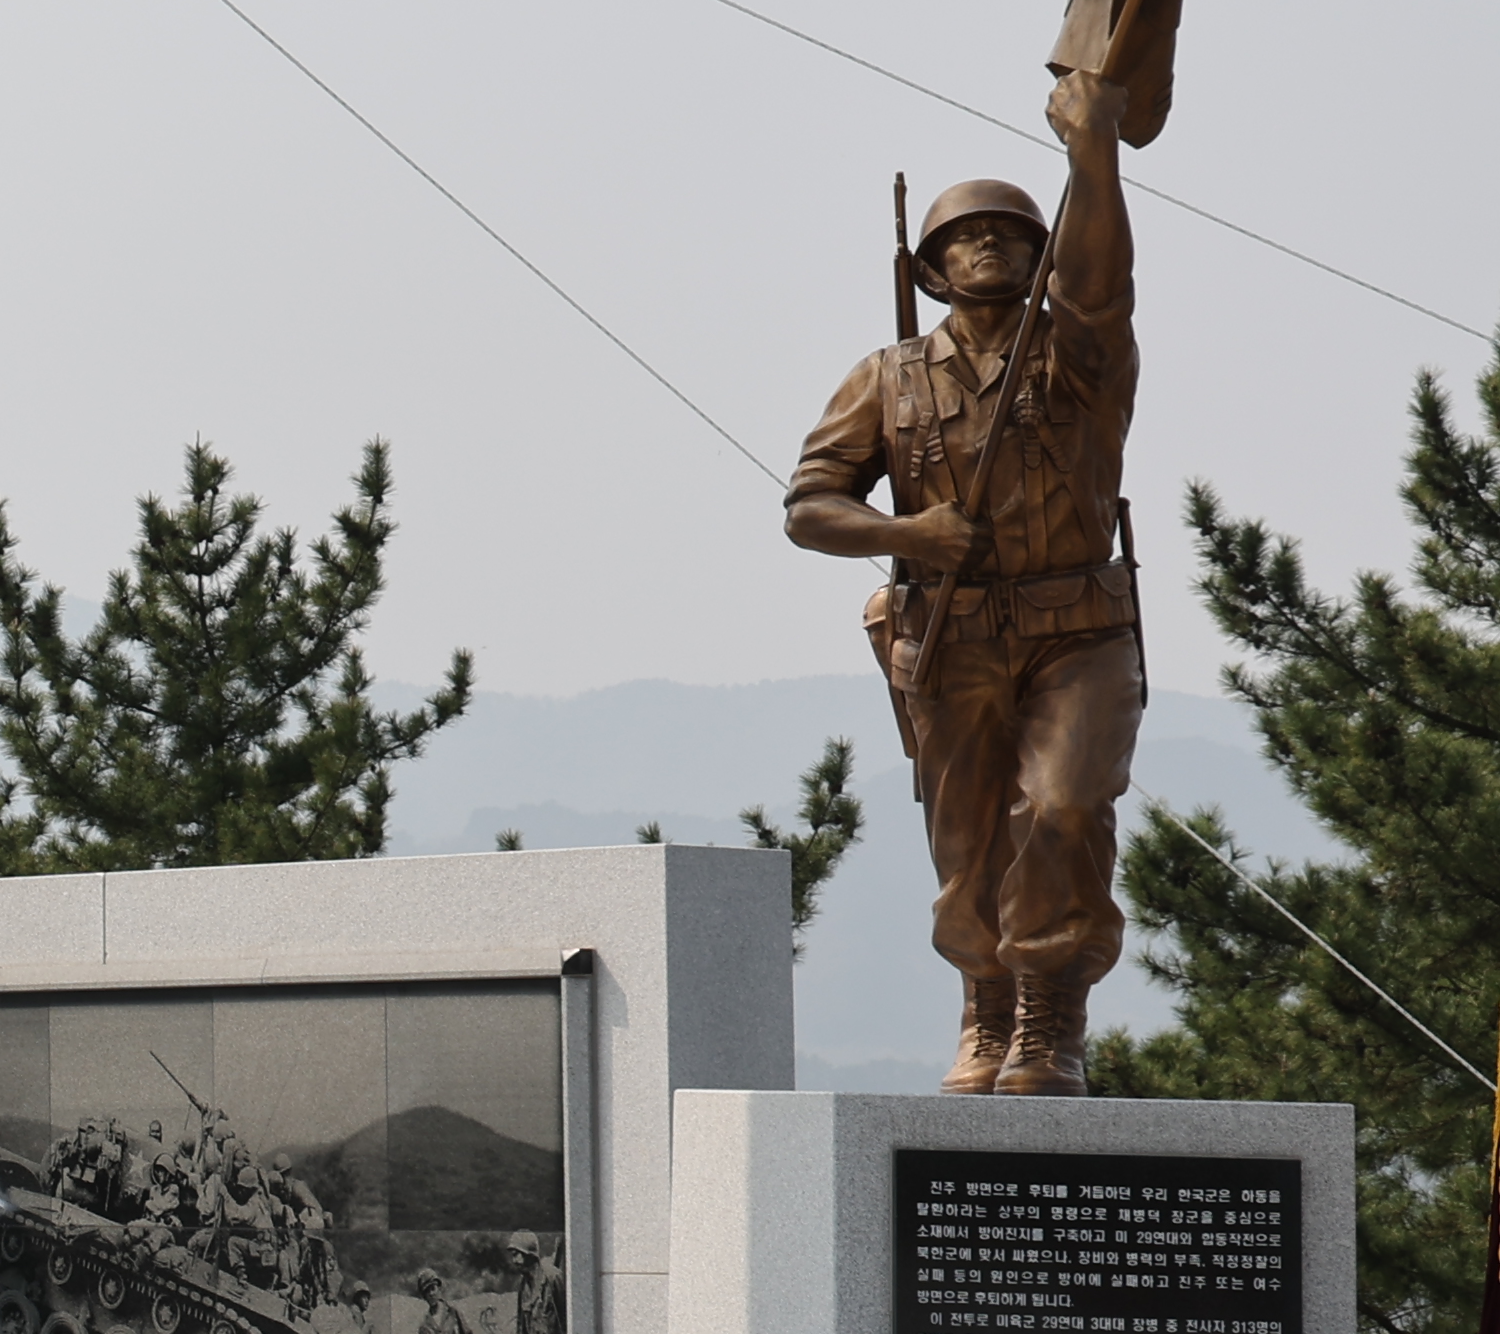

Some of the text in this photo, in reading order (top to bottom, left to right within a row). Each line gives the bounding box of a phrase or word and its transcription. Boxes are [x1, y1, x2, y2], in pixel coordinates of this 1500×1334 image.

[917, 1267, 1281, 1291] 실패 등의 원인으로 방어에 실패하고 진주 또는 여수
[917, 1290, 1074, 1308] 방면으로 후퇴하게 됩니다.
[930, 1311, 1282, 1334] 이 전투로 미육군 29연대 3대대 장병 중 전사자 313명의
